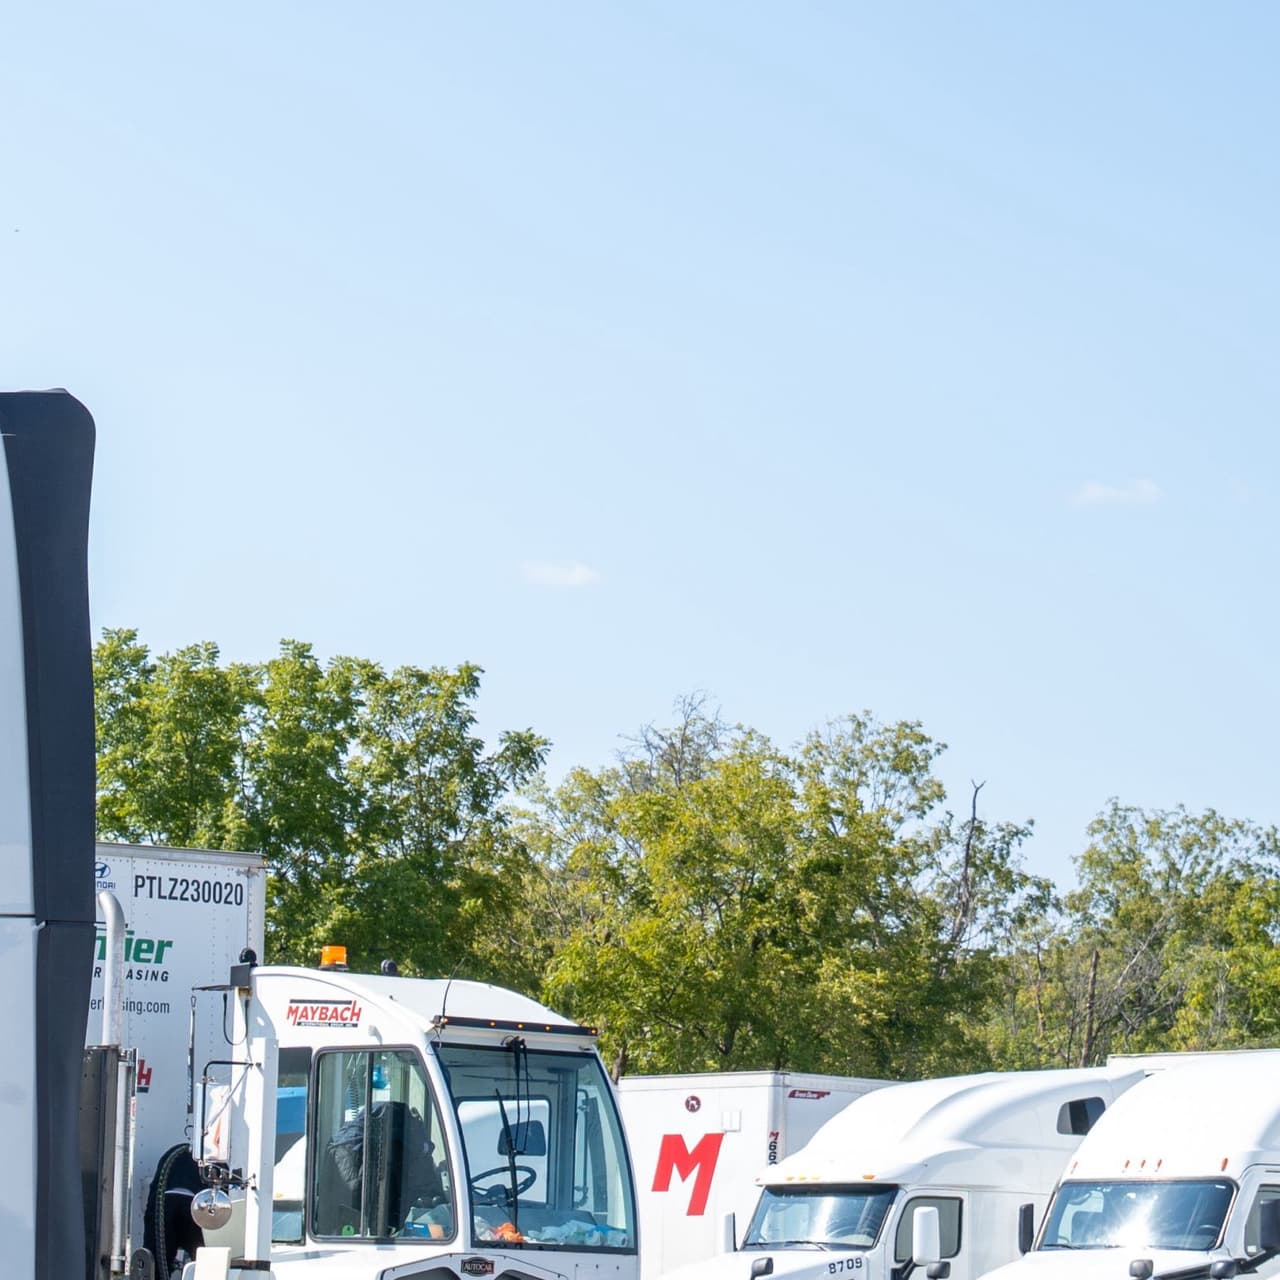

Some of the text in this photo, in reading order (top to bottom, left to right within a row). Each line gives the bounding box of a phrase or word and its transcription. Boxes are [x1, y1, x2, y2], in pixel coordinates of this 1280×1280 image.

[134, 874, 244, 906] PTLZ230020
[286, 999, 362, 1026] MAYBACH
[651, 1132, 726, 1216] M
[828, 1257, 863, 1274] 8709
